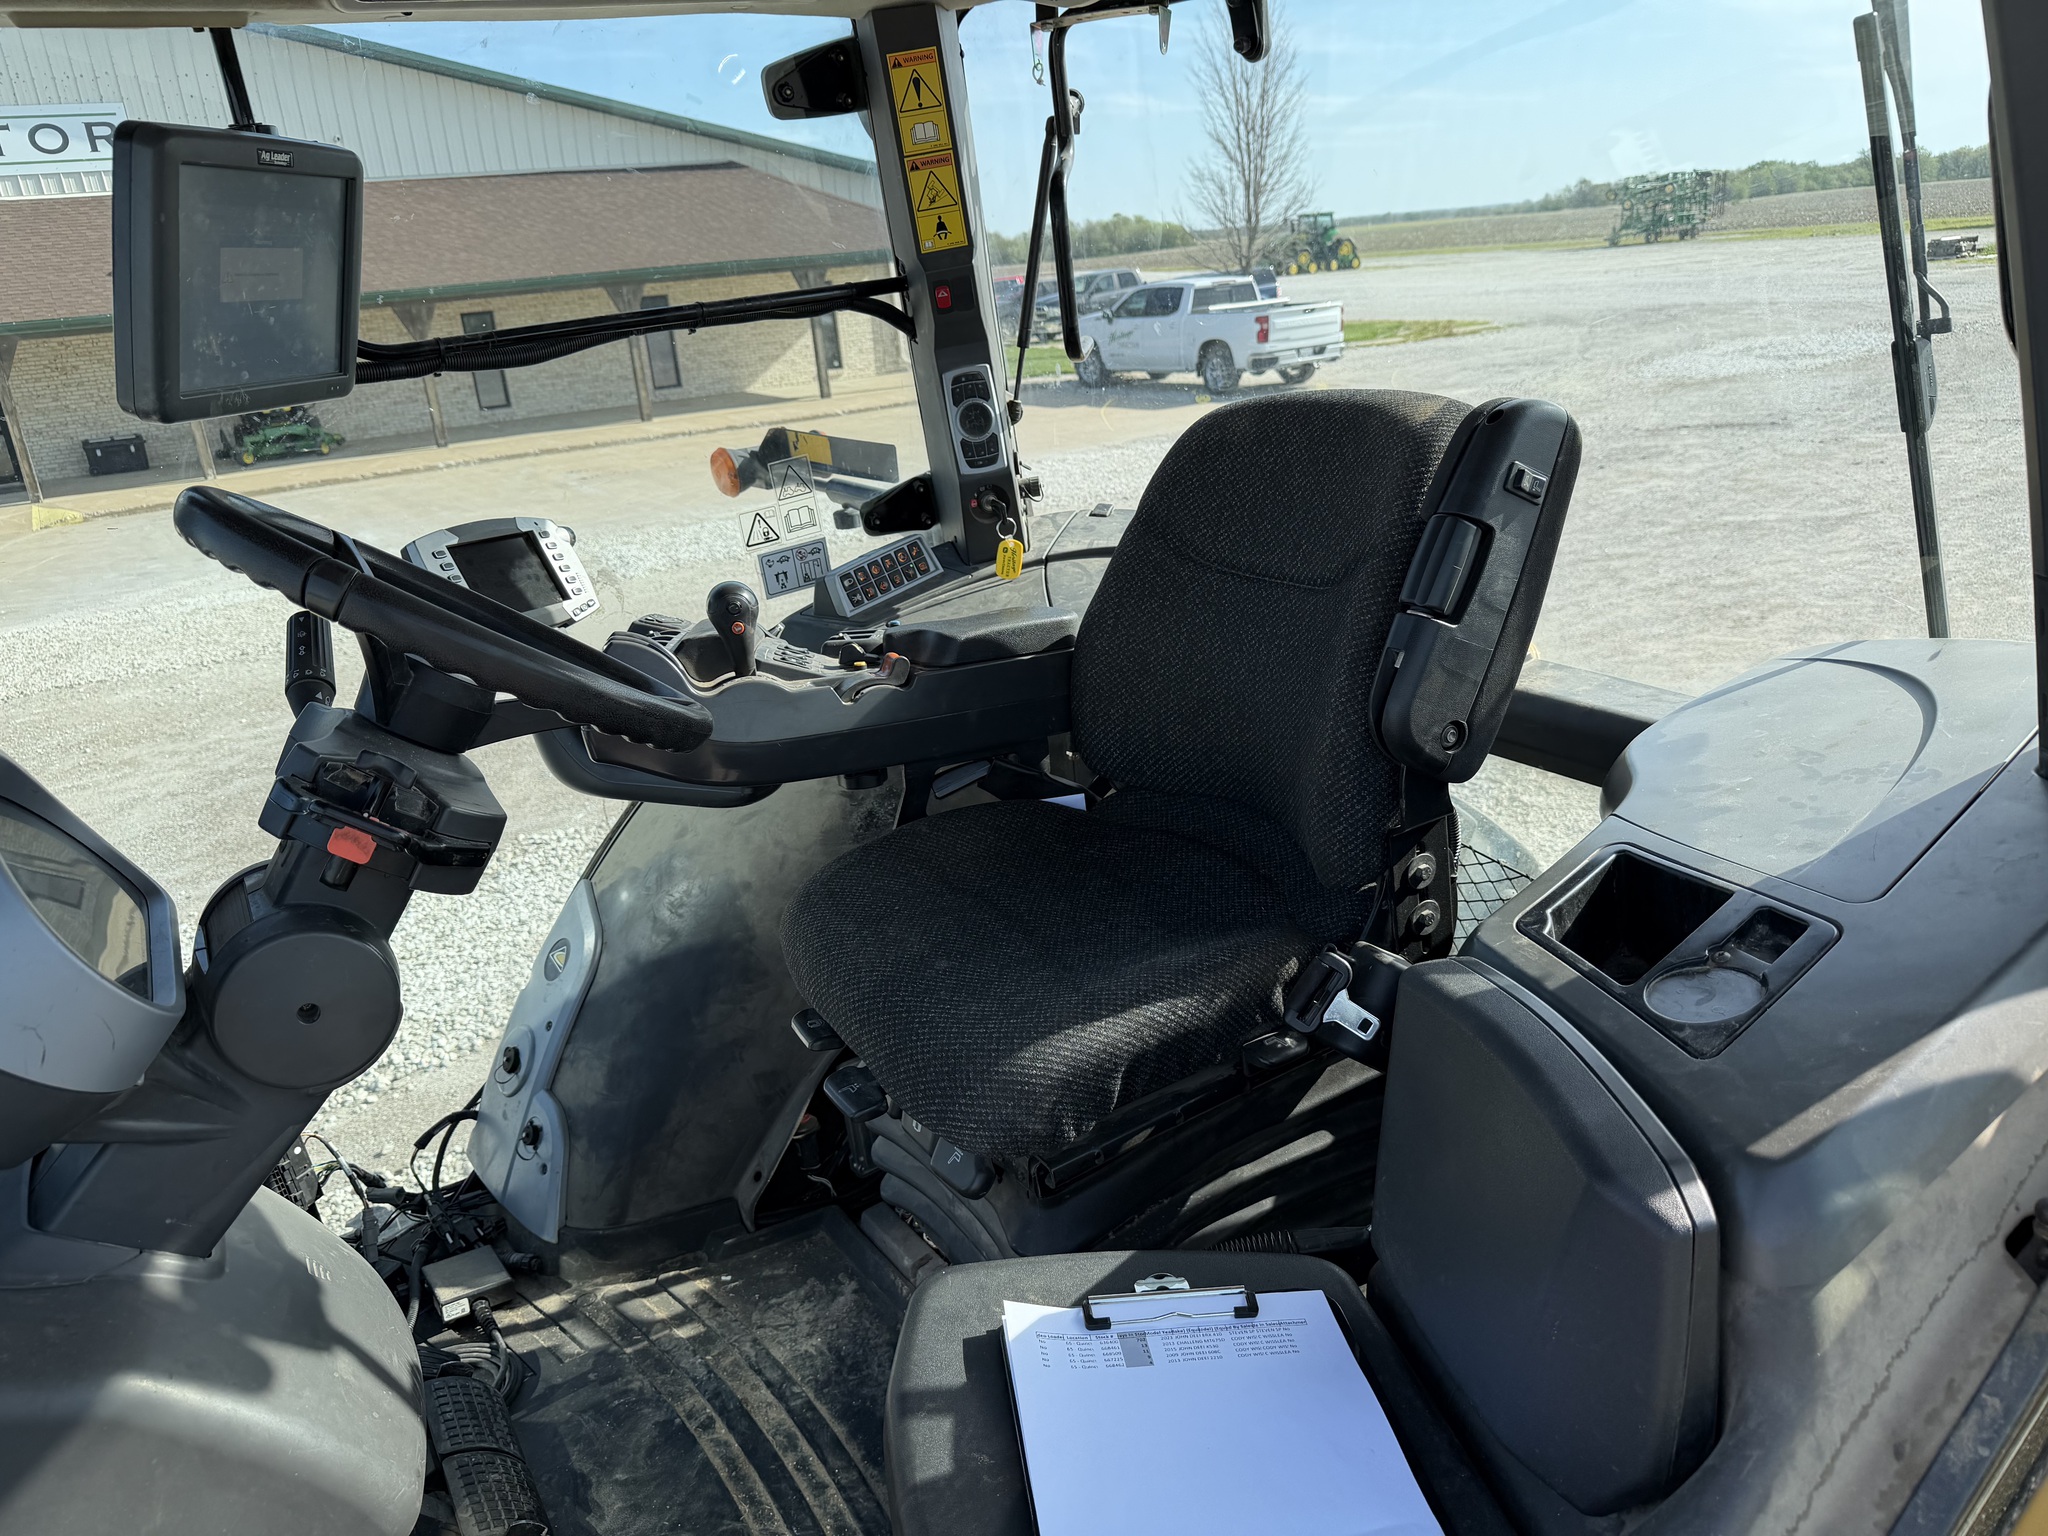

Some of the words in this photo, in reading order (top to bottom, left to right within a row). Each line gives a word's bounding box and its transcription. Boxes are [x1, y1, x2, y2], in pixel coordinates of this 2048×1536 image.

[902, 52, 934, 64] WARNING
[261, 150, 270, 161] Ag
[270, 151, 290, 162] Leader
[920, 156, 950, 167] WARNING
